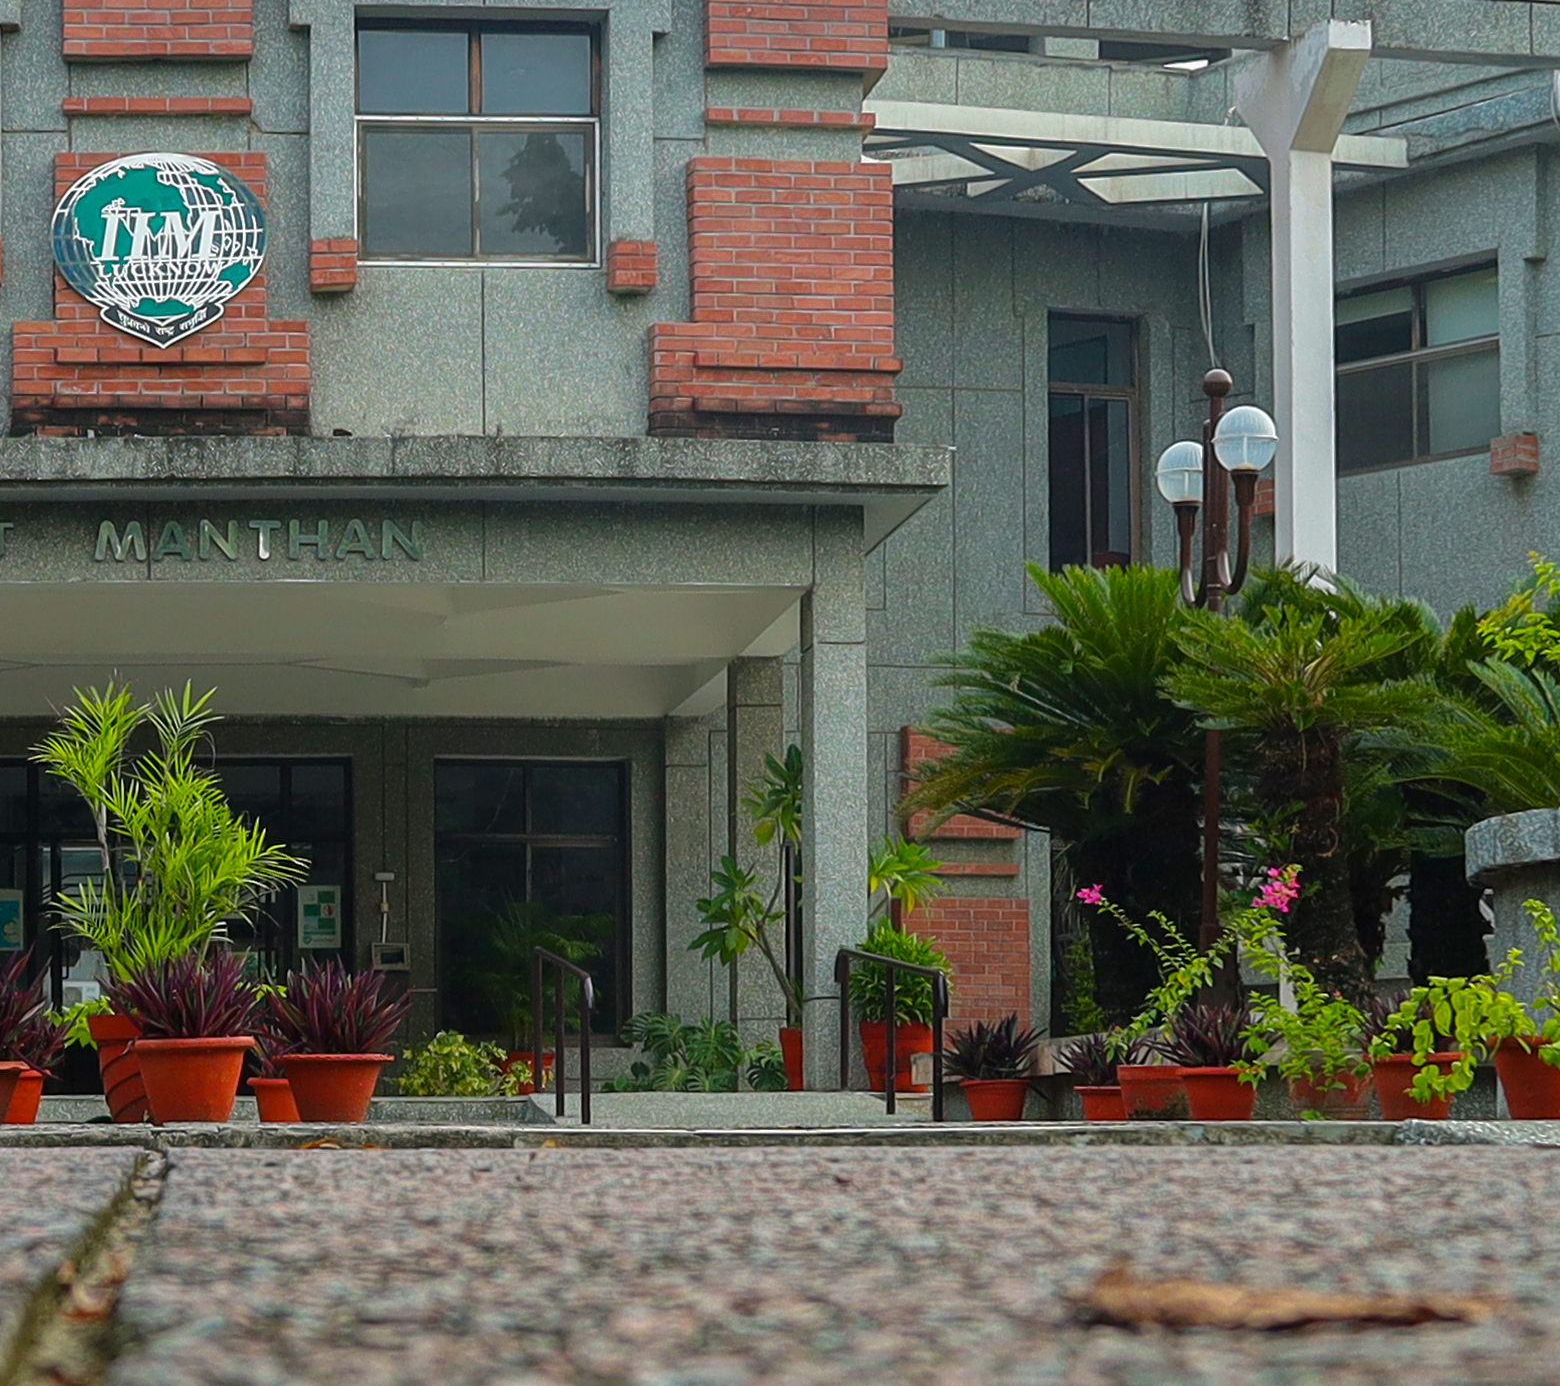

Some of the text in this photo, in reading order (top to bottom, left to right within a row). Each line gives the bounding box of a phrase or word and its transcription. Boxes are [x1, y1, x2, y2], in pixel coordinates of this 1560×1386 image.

[94, 212, 221, 261] IIM
[97, 262, 223, 278] LUCKNOW
[94, 519, 425, 561] MANTHAN
